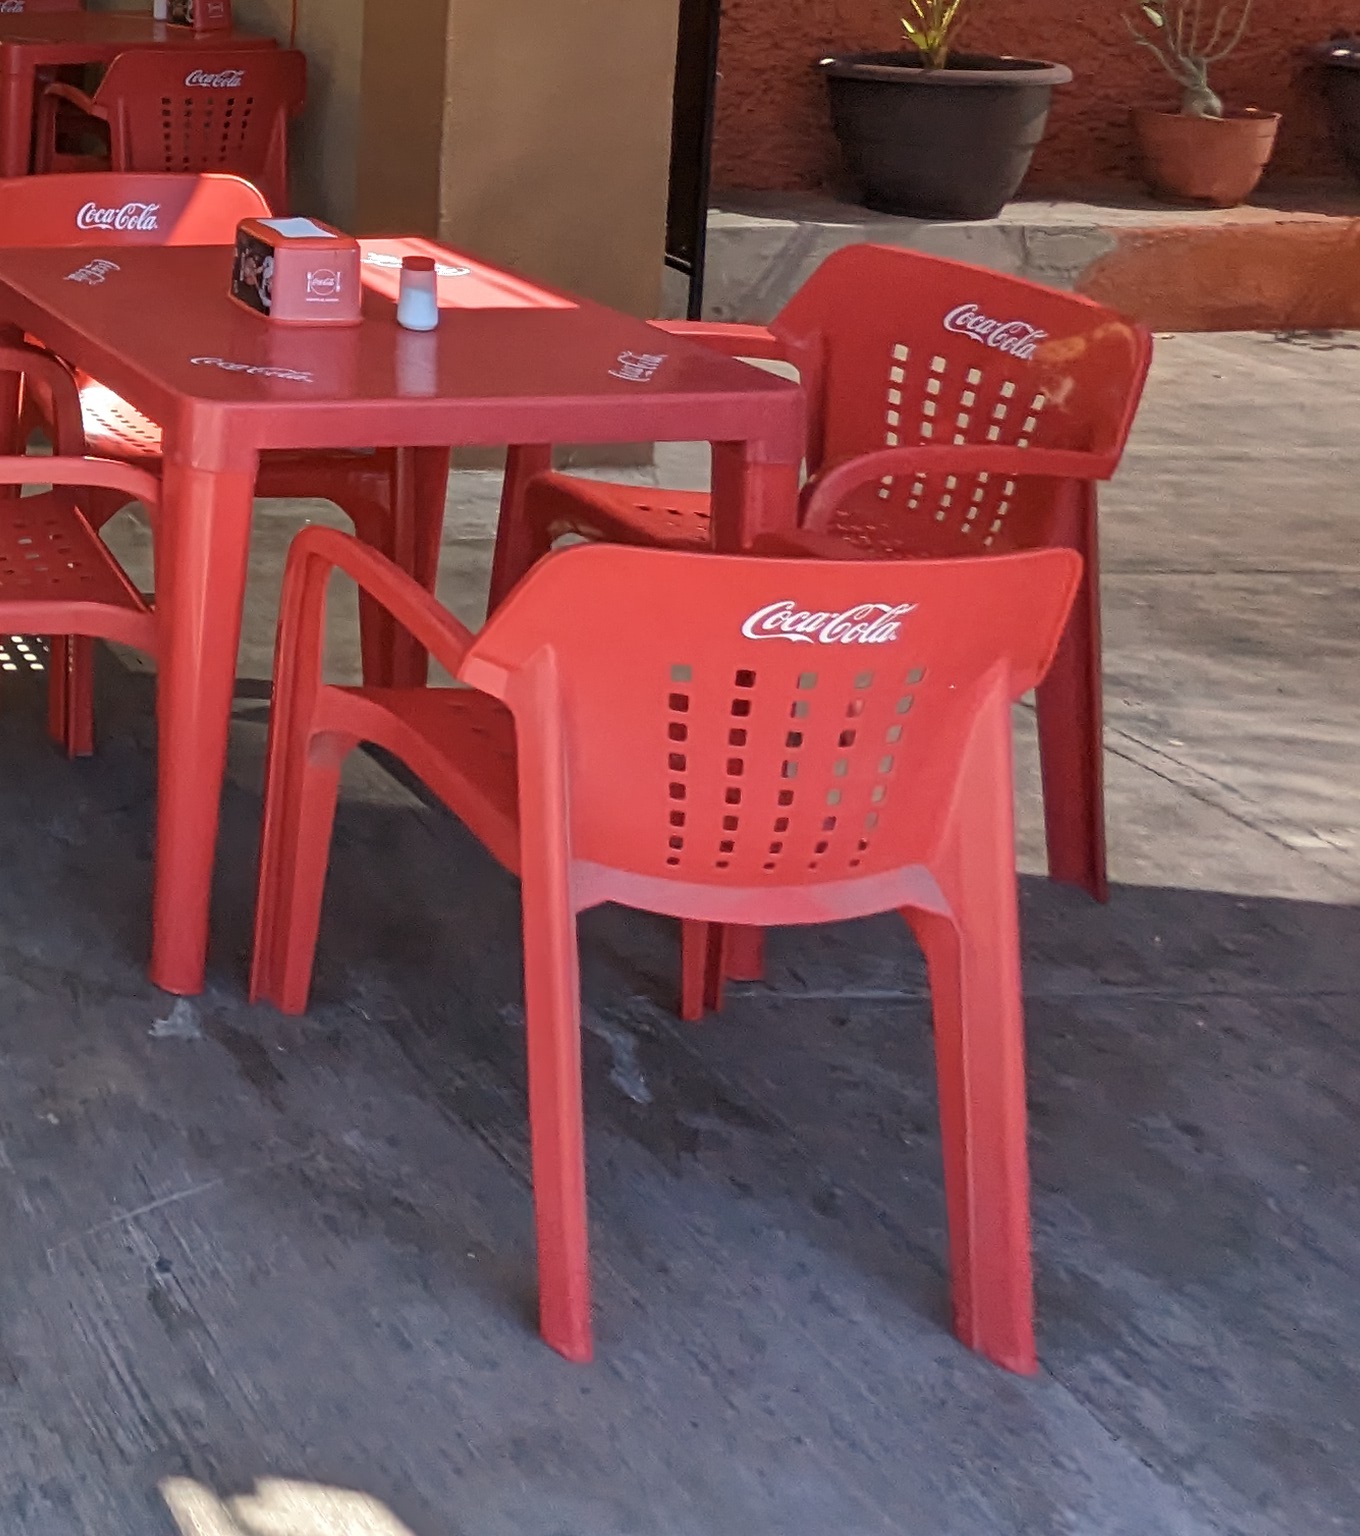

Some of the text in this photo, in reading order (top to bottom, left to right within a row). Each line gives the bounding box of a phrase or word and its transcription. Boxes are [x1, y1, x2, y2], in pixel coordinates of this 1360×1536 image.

[185, 70, 245, 87] Coca-Cola
[76, 202, 160, 231] Coca-Cola
[943, 304, 1048, 360] Coca-Cola
[741, 601, 919, 644] Coca-Cola
